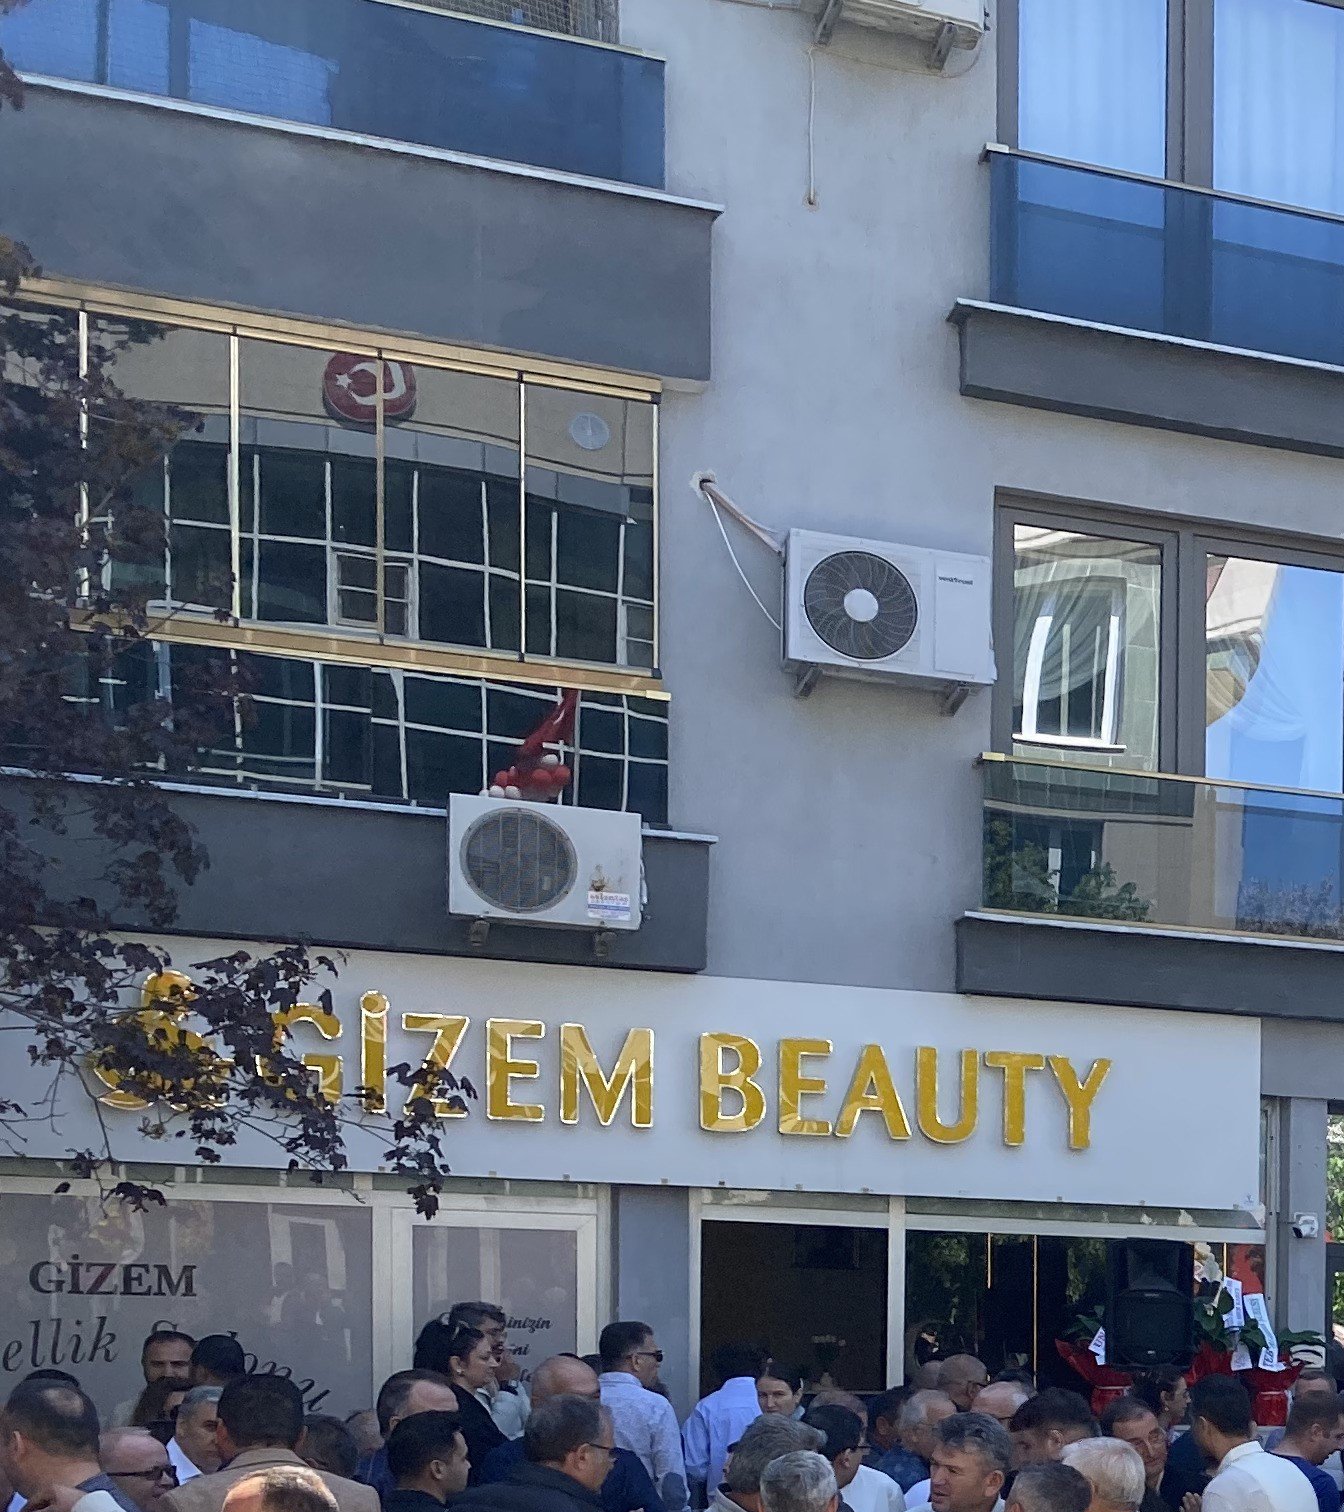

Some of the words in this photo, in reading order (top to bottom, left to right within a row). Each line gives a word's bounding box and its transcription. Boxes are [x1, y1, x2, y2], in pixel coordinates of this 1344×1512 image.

[254, 989, 655, 1129] GİZEM
[698, 1031, 1112, 1151] BEAUTY
[28, 1253, 198, 1298] GİZEM
